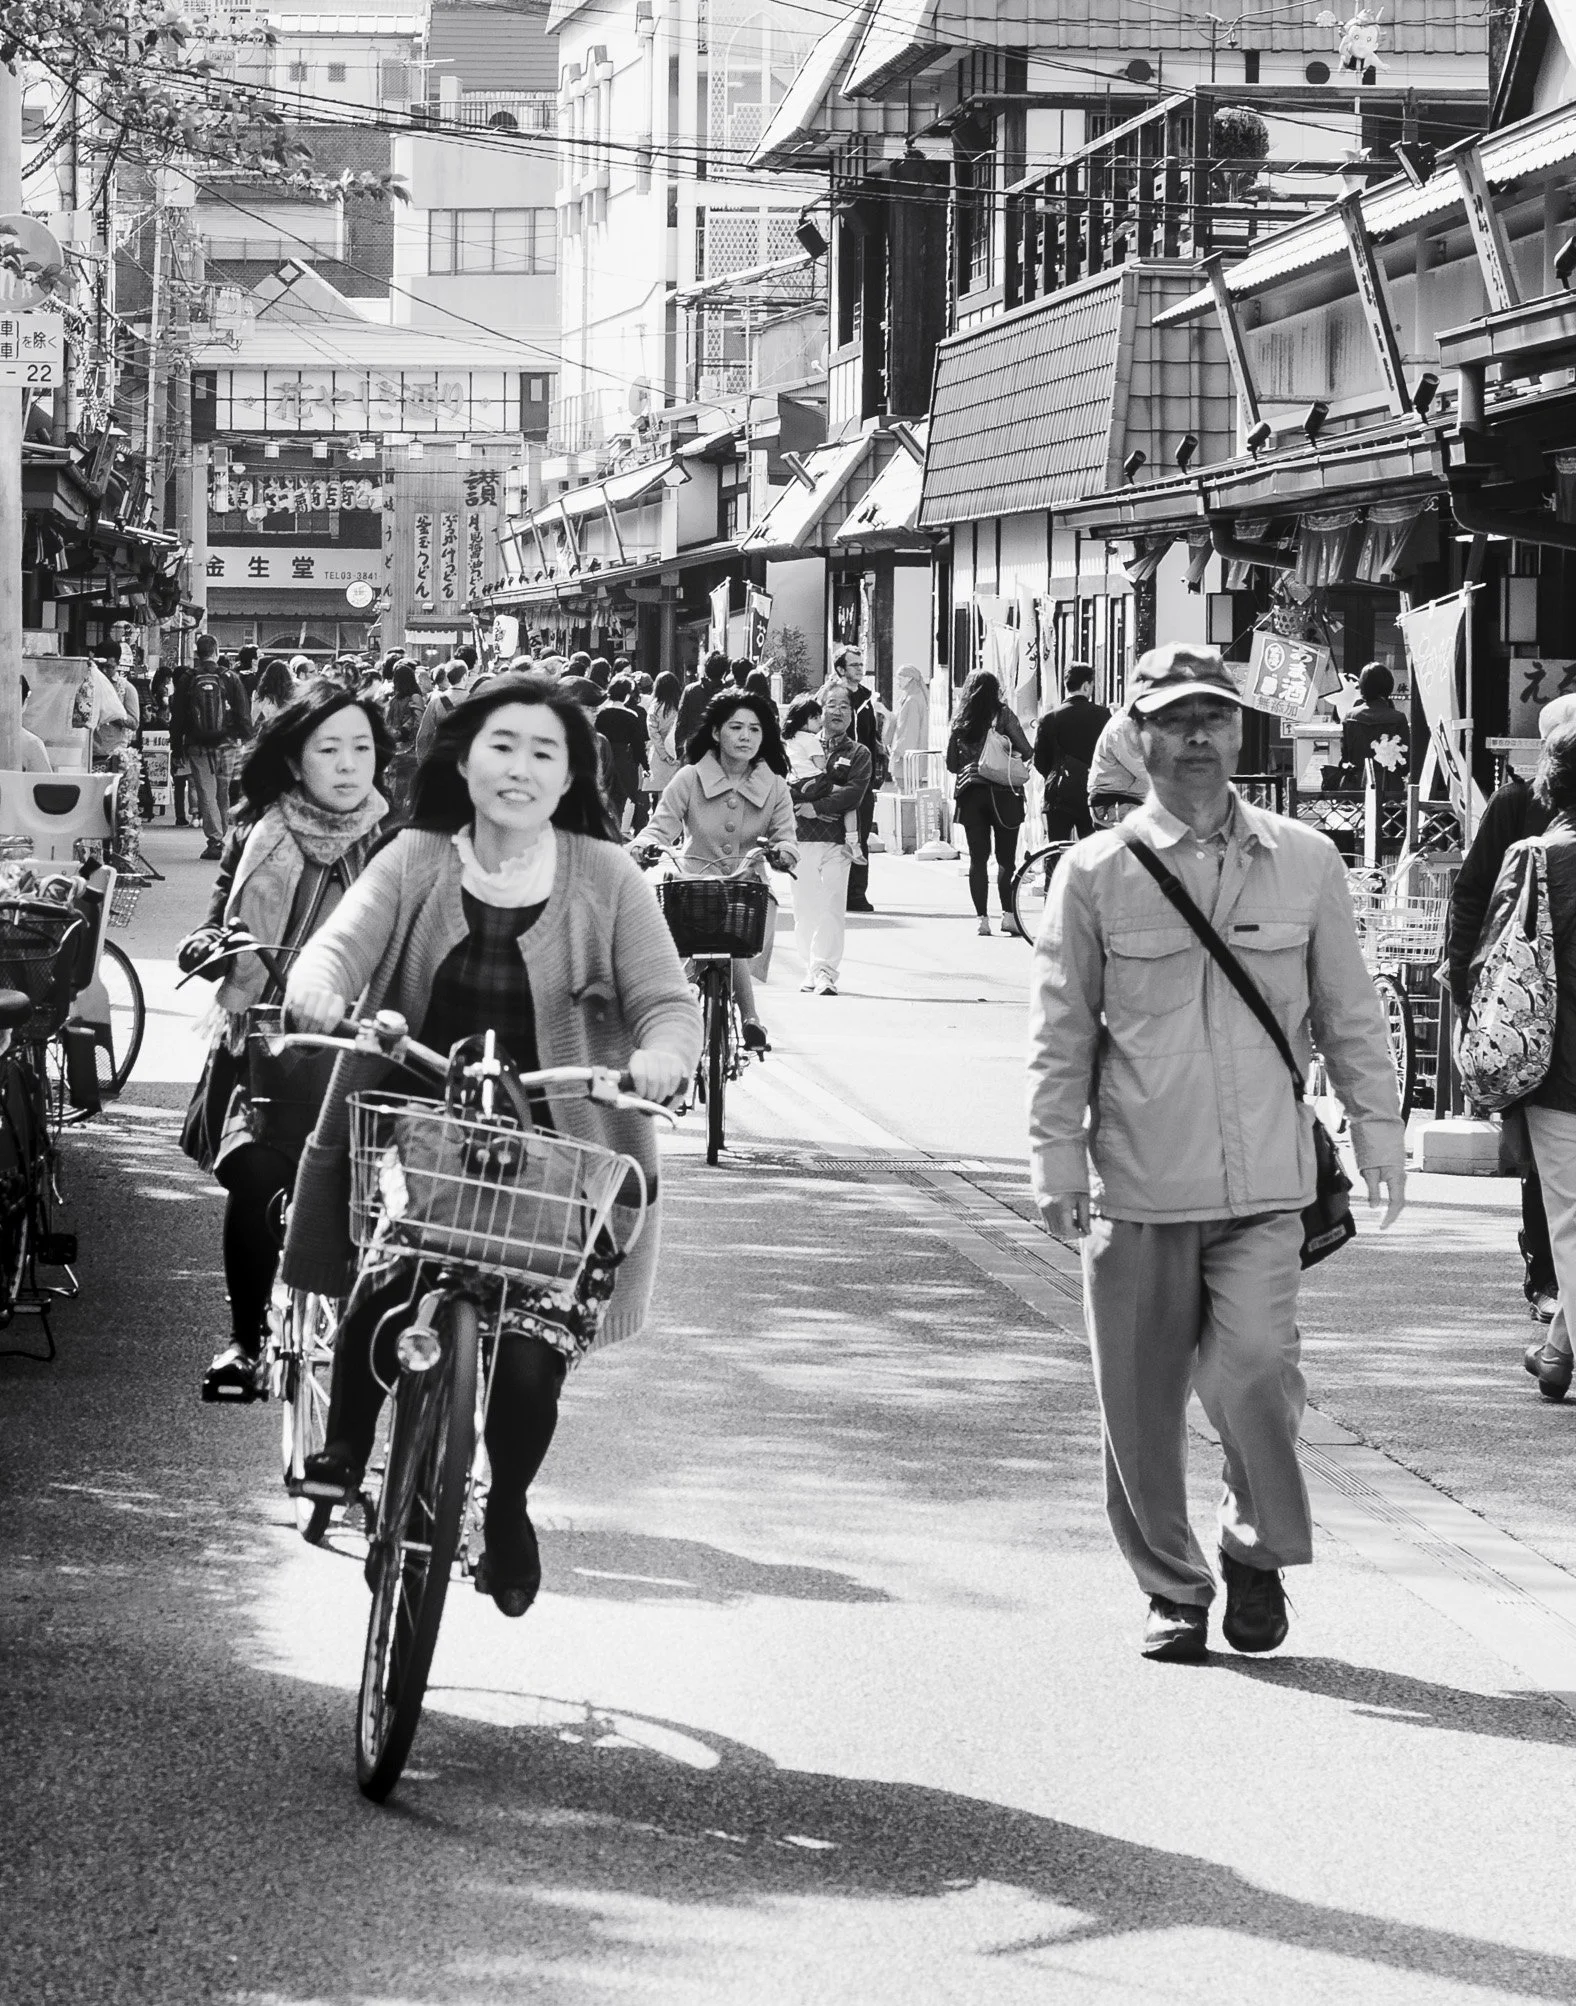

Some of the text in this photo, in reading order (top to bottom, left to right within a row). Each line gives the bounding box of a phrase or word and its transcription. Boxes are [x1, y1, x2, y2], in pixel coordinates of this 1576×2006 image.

[22, 331, 57, 349] を除く
[27, 364, 52, 382] 22
[273, 380, 464, 420] 花やしき通り
[207, 553, 315, 579] 金生堂
[415, 514, 432, 599] 釜玉うどん
[441, 513, 459, 599] ぶっかけうどん
[1278, 648, 1314, 705] あま酒
[1256, 696, 1298, 717] 無添加
